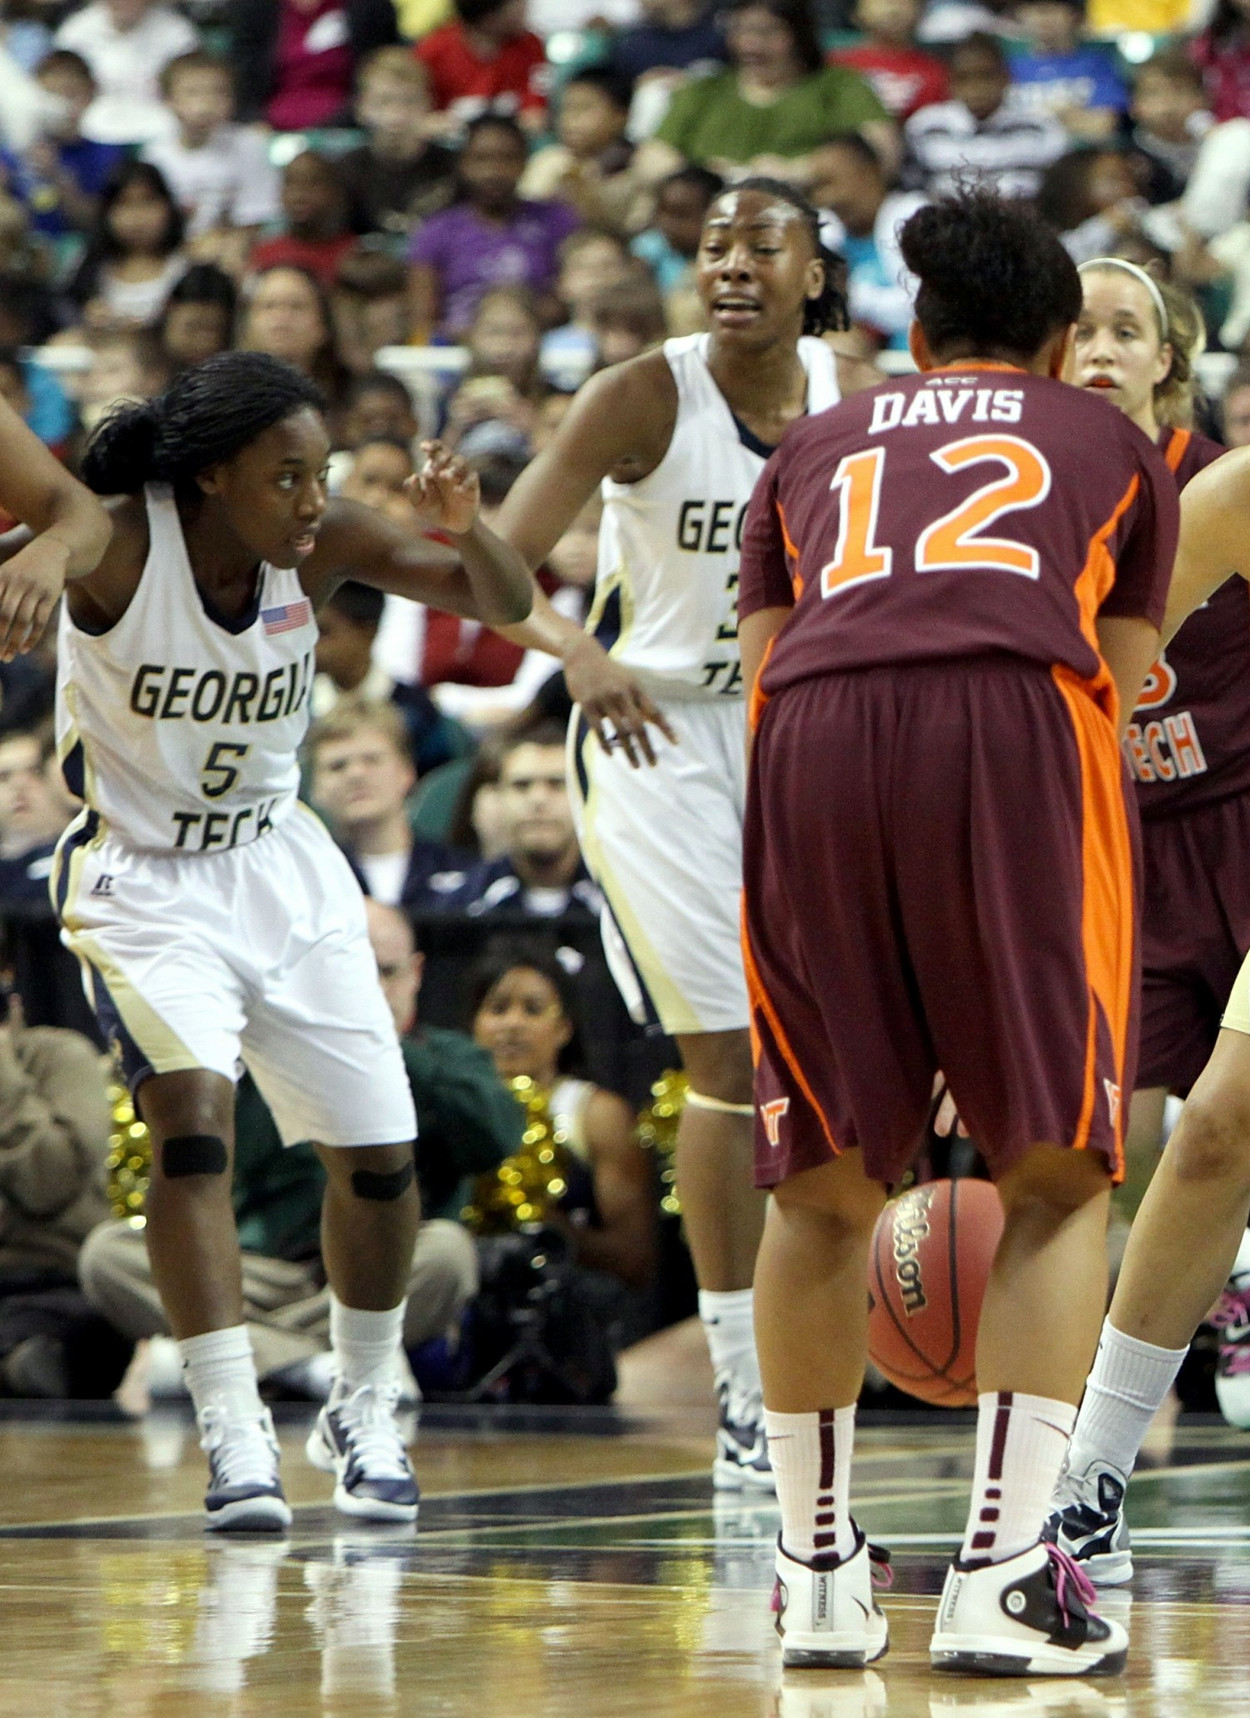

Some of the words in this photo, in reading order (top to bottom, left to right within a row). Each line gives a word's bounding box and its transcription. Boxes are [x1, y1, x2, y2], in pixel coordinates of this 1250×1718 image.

[867, 389, 1025, 435] DAVIS
[820, 433, 1052, 600] 12
[201, 741, 250, 799] 5
[1122, 711, 1208, 782] ECH
